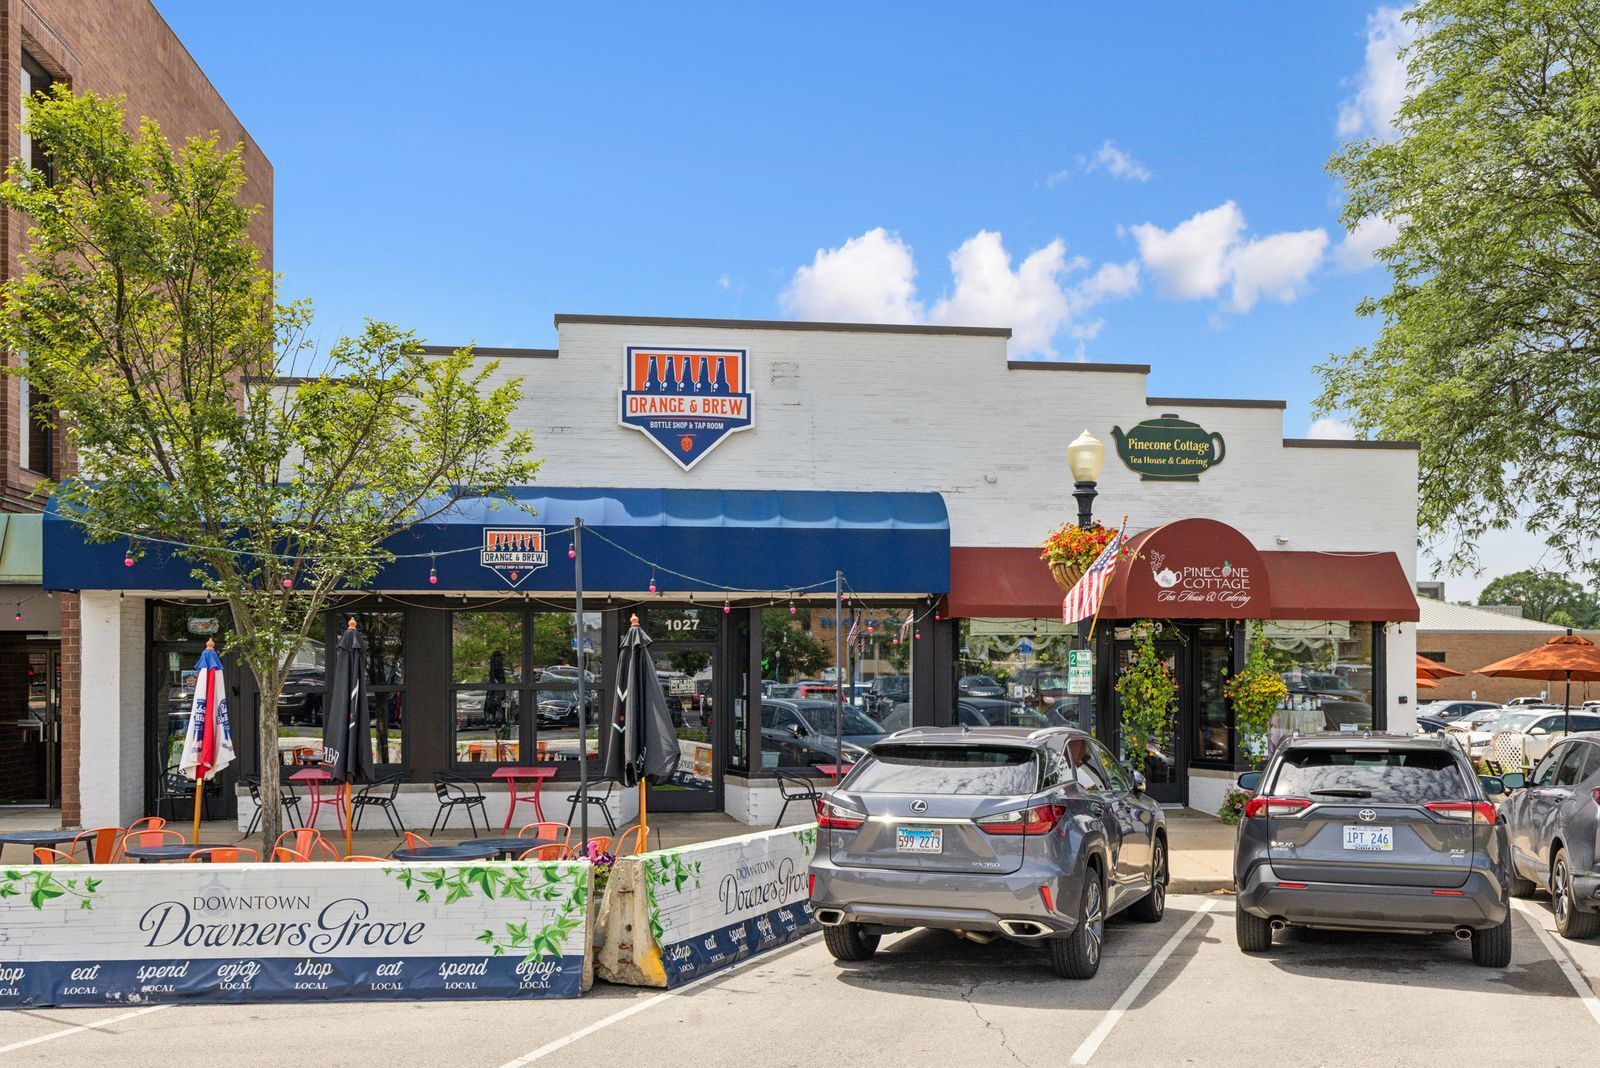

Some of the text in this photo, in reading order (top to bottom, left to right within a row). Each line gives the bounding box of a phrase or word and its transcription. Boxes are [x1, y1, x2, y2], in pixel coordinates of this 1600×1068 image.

[629, 397, 743, 416] ORANGE & BREW
[650, 421, 672, 429] BOTTLE
[672, 421, 688, 429] SHOP
[706, 422, 724, 430] ROOM
[1128, 438, 1210, 456] Pinecone Cottage
[1129, 455, 1209, 468] Tea House & Catering
[485, 553, 514, 562] ORANGE
[522, 553, 544, 563] BREW
[1183, 578, 1251, 590] COTTAGE
[1158, 590, 1176, 602] Tea
[1177, 590, 1205, 602] House
[1217, 590, 1251, 609] Catering
[665, 619, 700, 631] 1027
[1070, 654, 1077, 665] 2
[898, 835, 940, 849] 599 2273
[1347, 831, 1389, 845] 1PT 246
[736, 860, 777, 881] DOWNTOWN
[193, 895, 311, 911] DOWNTOWN
[139, 897, 426, 955] Downers Grove
[670, 944, 692, 962] shop
[704, 934, 718, 951] eat
[729, 922, 747, 945] spend
[679, 962, 695, 973] LOCAL
[710, 952, 725, 963] LOCAL
[0, 958, 555, 985] hop eat spend enjoy shop eat spend enjoy
[0, 981, 551, 996] CAL LOCAL OCAL LOCAL LOCAL LOCAL LOCAL LOCAL
